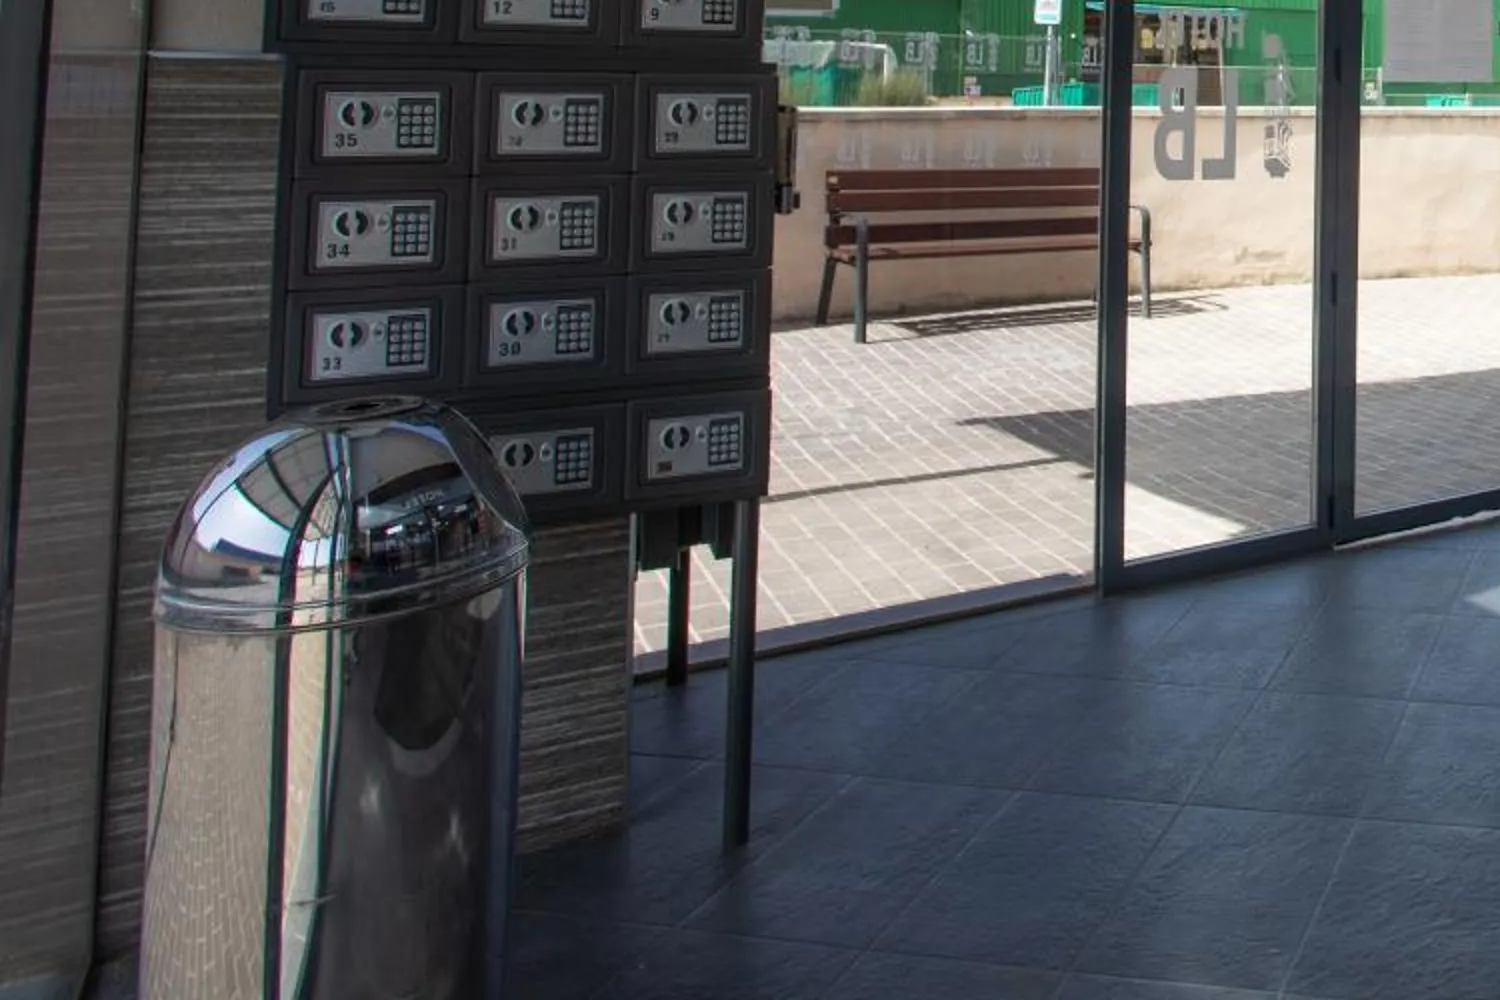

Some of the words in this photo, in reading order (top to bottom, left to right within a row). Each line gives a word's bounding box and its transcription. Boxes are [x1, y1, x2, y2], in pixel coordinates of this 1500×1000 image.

[493, 0, 513, 15] 12
[650, 7, 660, 21] 9
[335, 133, 358, 149] 35
[327, 243, 350, 259] 34
[501, 237, 517, 251] 31
[498, 341, 521, 357] 30
[322, 357, 342, 371] 33
